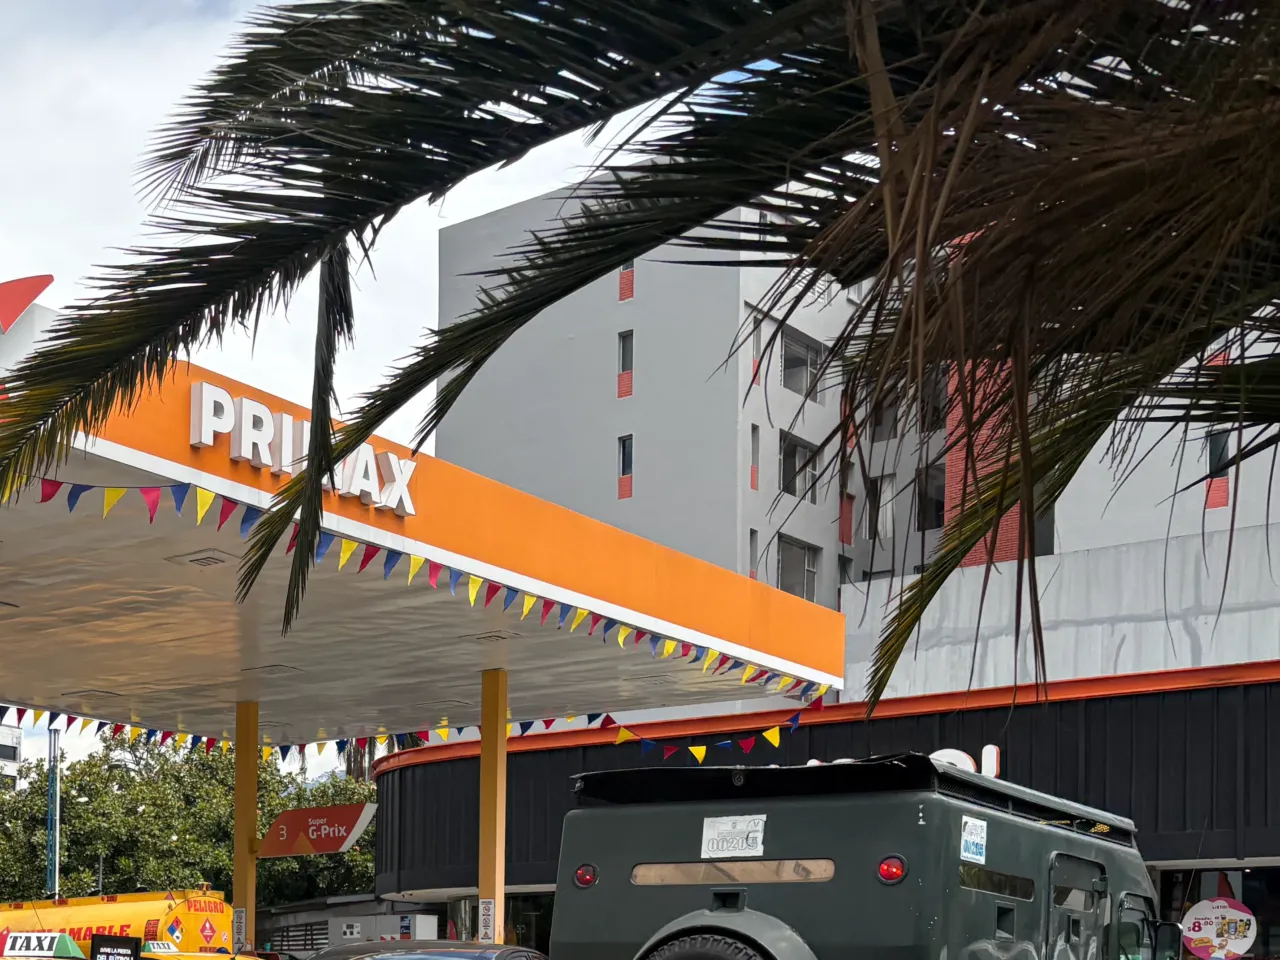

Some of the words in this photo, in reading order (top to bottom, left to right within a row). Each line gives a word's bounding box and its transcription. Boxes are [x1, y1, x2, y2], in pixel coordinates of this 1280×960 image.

[308, 818, 327, 826] Super
[278, 825, 287, 840] 3
[308, 823, 348, 839] G-Prix
[186, 899, 225, 914] PELIGRO
[8, 935, 58, 952] TAXI
[151, 942, 171, 951] TAXI
